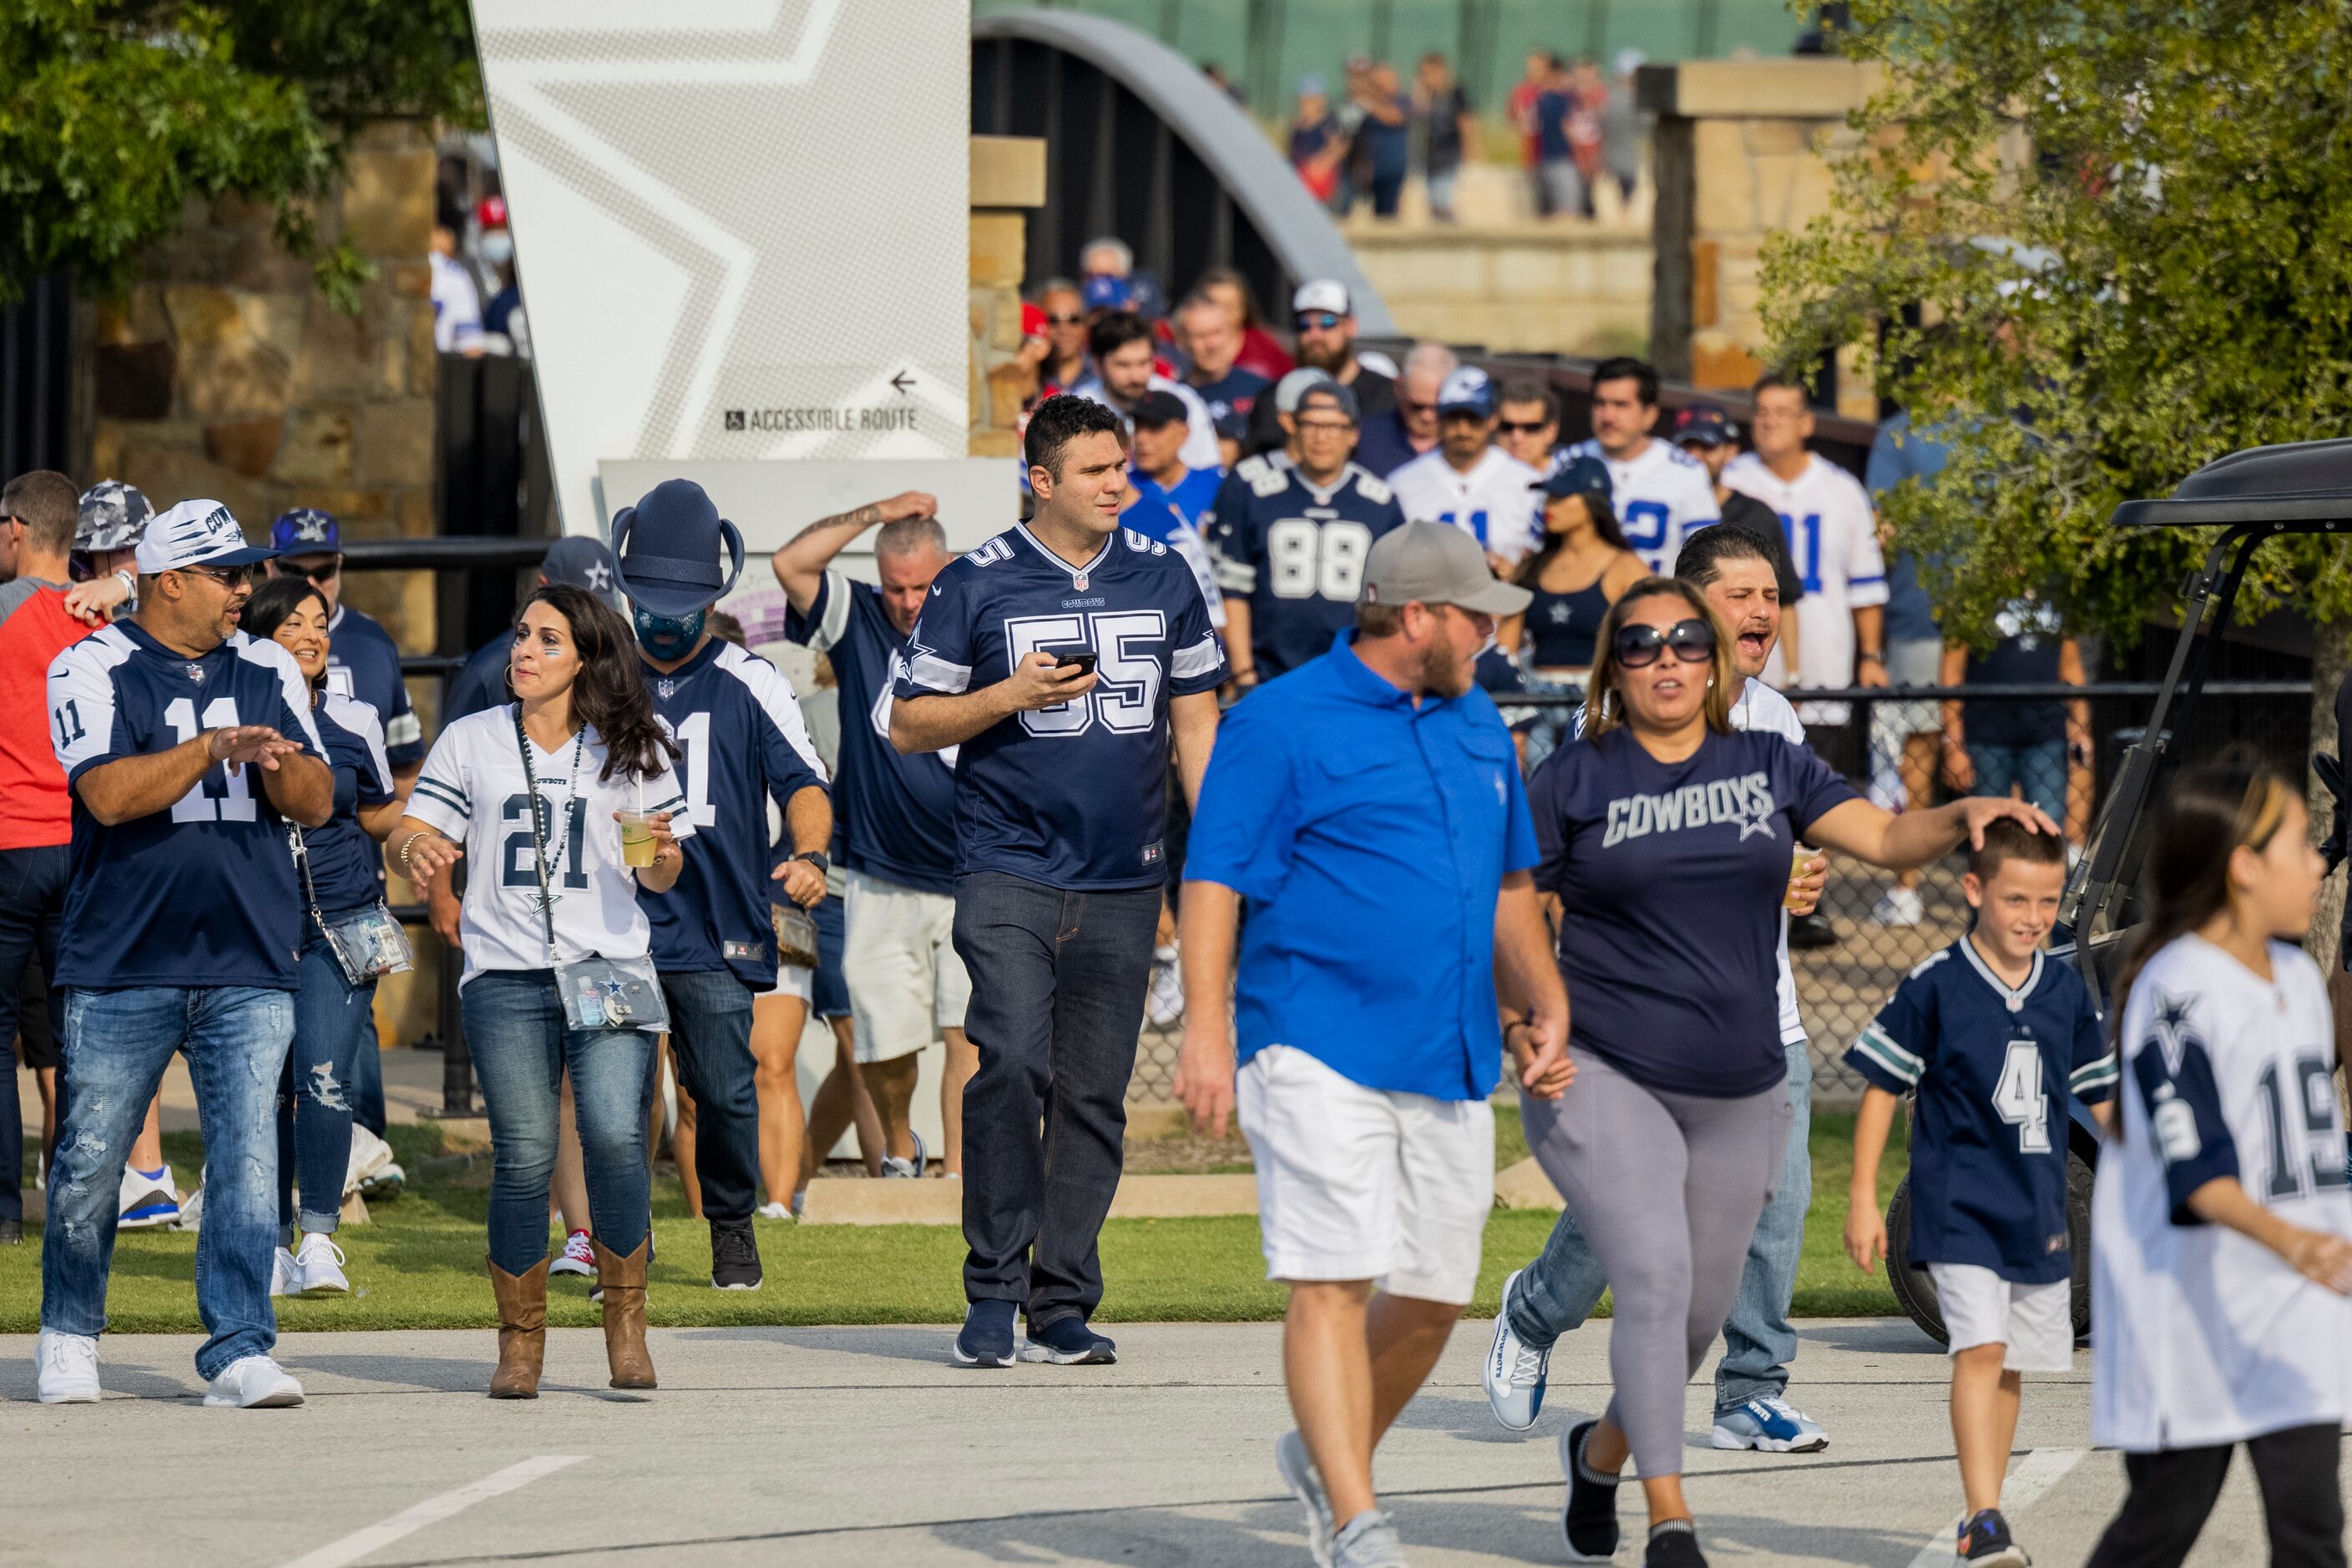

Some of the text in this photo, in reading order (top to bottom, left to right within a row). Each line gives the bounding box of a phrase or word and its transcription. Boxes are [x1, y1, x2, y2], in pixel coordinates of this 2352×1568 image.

[752, 407, 918, 432] ACCESSIBLE ROUTE
[1075, 579, 1089, 589] NFL
[1267, 517, 1373, 603] 88
[1061, 597, 1105, 609] COWBOYS
[1004, 609, 1166, 738] 55
[54, 699, 87, 751] 11
[164, 696, 257, 824] 11
[534, 777, 568, 786] OWBOYS
[653, 711, 716, 827] 1
[501, 792, 589, 891] 21
[1601, 770, 1776, 849] COWBOYS
[1991, 1040, 2051, 1154] 4
[1495, 1328, 1510, 1379] COWBOYS
